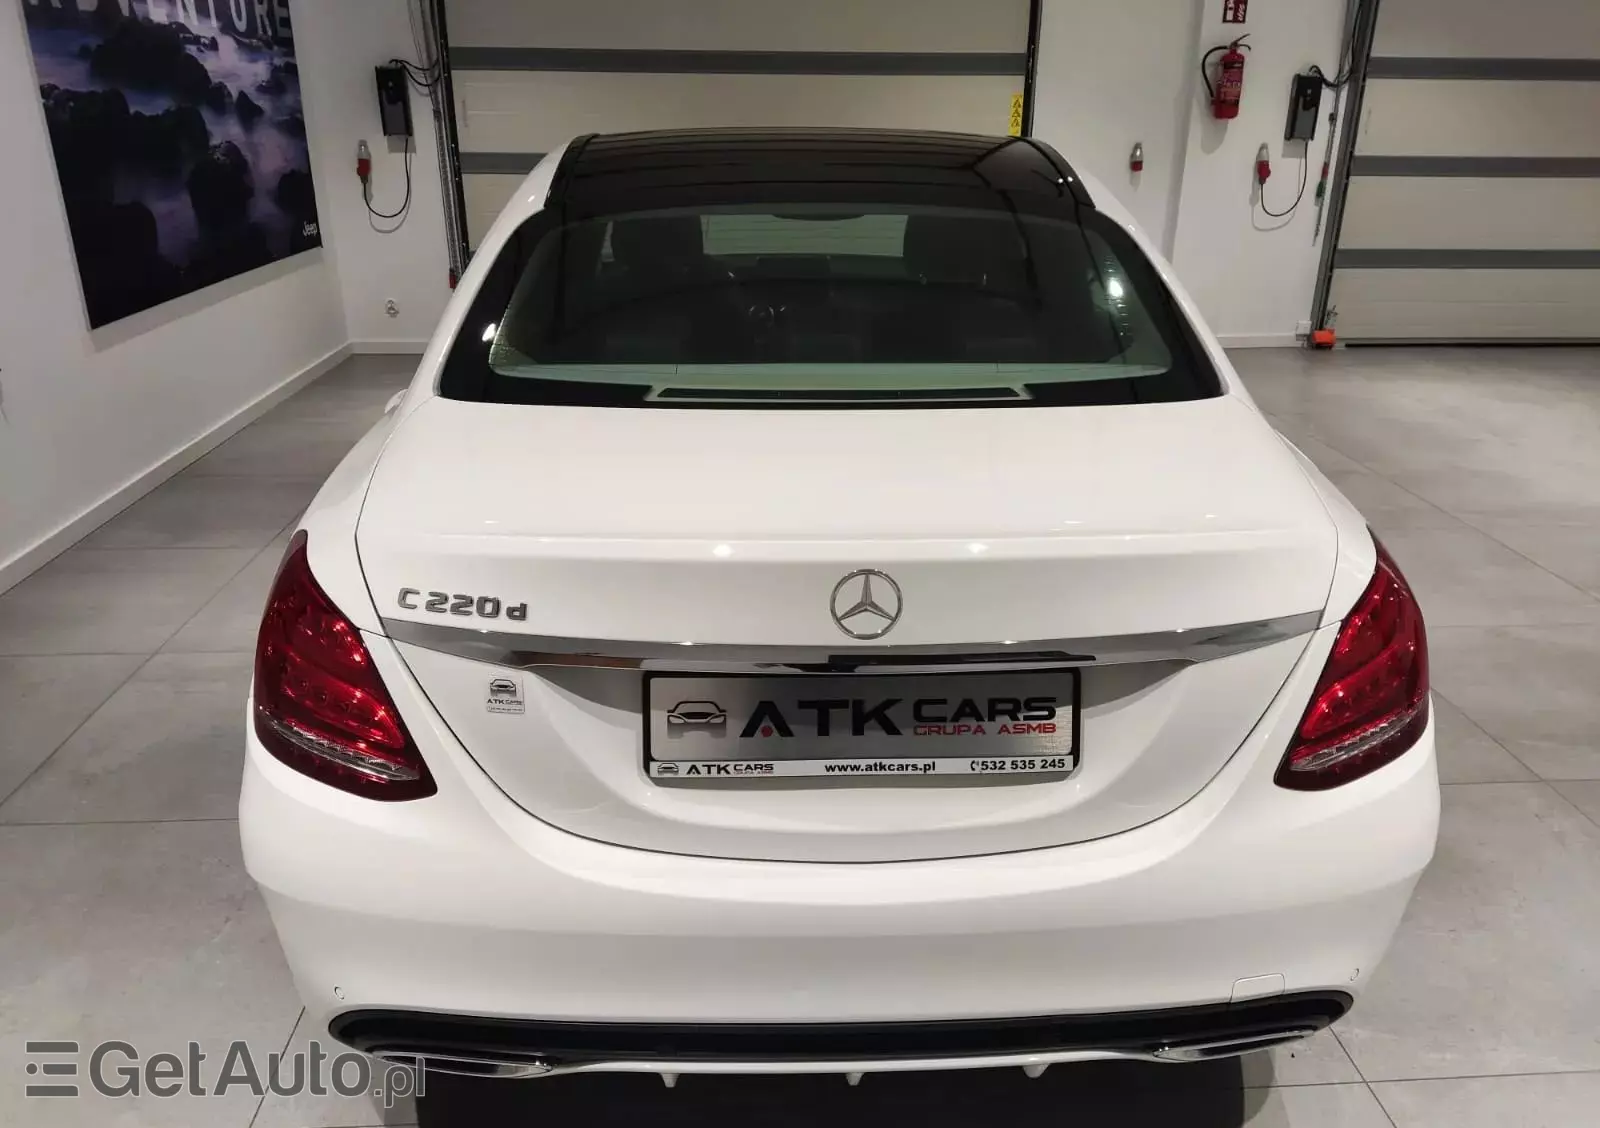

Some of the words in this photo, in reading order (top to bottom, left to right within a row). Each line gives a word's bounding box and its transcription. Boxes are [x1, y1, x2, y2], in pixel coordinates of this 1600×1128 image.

[27, 0, 292, 38] NTURE
[302, 219, 318, 237] Jeep
[397, 587, 421, 610] C
[424, 591, 502, 618] 220
[506, 602, 528, 621] d
[739, 699, 903, 738] ATK
[913, 697, 1057, 723] CARS
[913, 724, 987, 736] GRUPA
[996, 723, 1057, 735] ASMB
[686, 764, 731, 775] ATK
[733, 763, 774, 771] CARS
[824, 761, 936, 773] www.atkcars.pl
[981, 760, 1006, 771] 532
[1010, 759, 1036, 771] 535
[1040, 758, 1066, 770] 245
